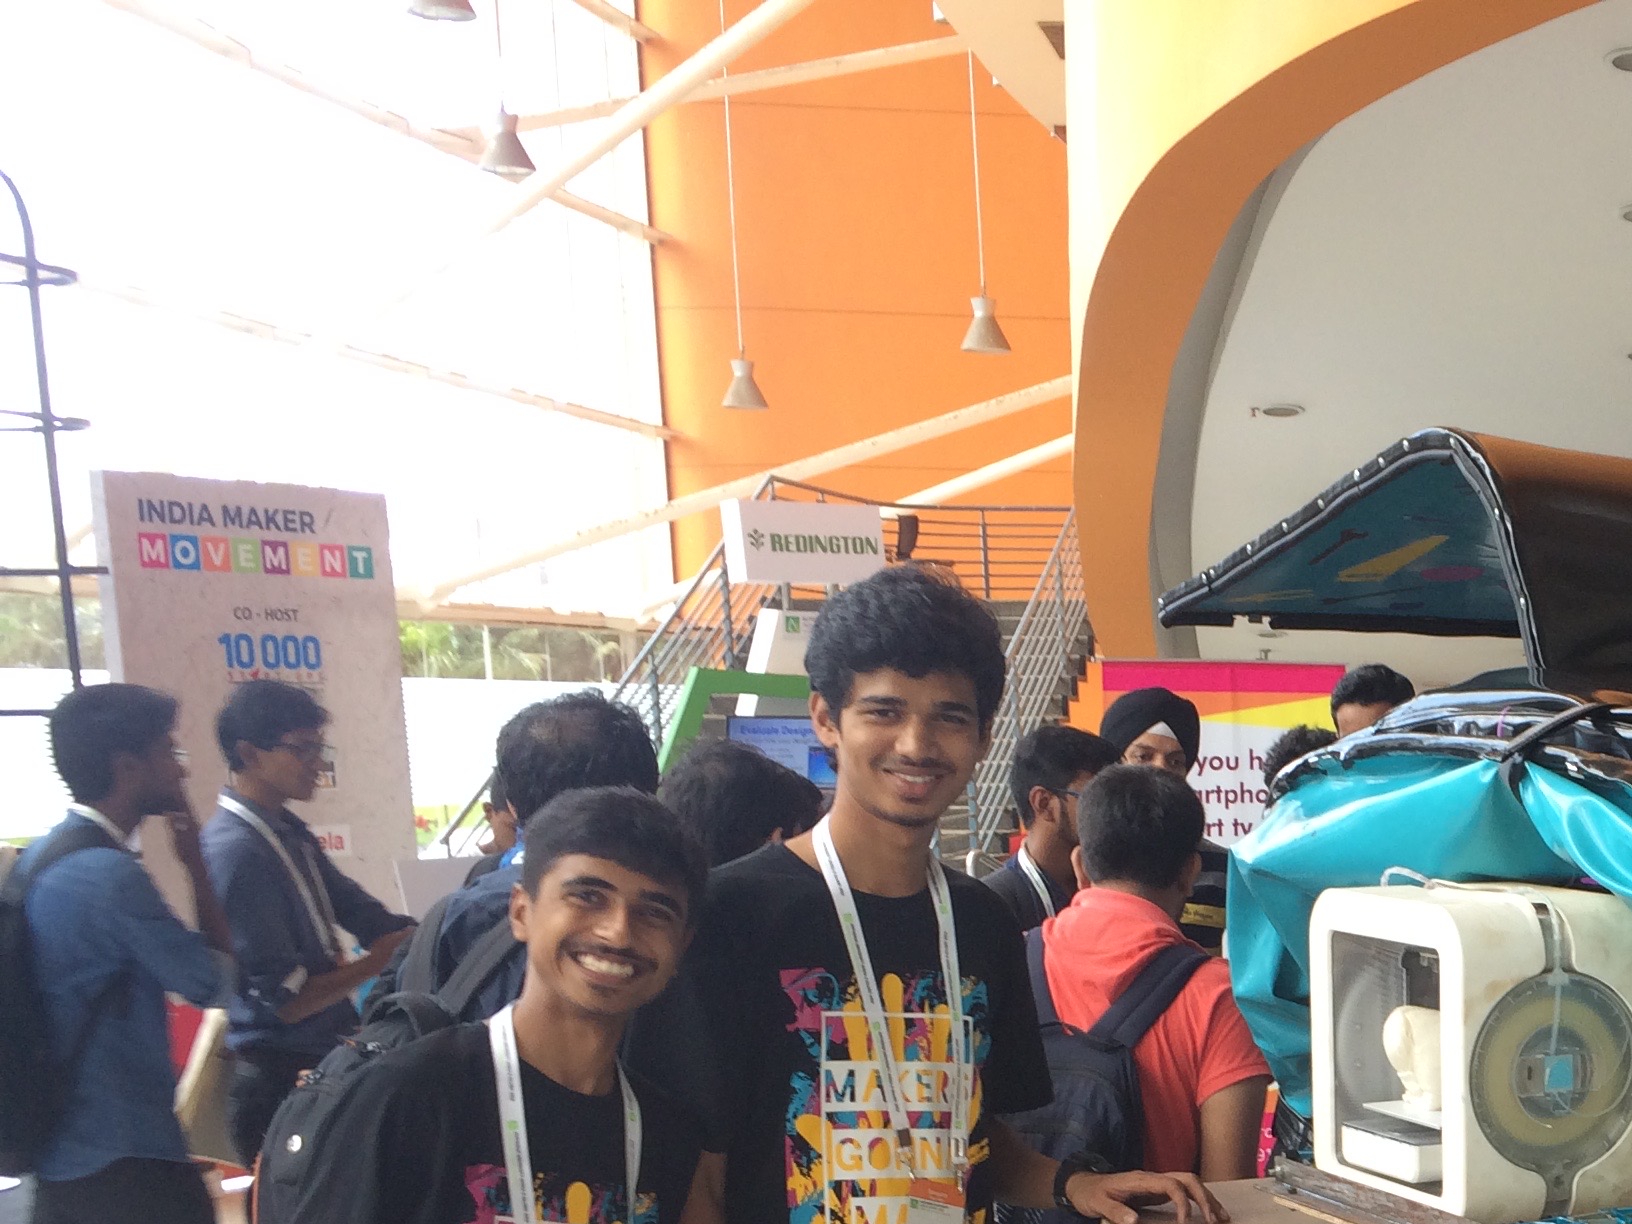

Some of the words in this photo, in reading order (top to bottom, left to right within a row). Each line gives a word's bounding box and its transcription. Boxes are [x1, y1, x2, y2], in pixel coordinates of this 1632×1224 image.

[138, 497, 216, 527] INDIA
[221, 504, 316, 534] MAKER
[769, 533, 879, 555] REDINGTON
[140, 534, 371, 577] MOVEMENT
[265, 607, 299, 622] HOST
[1196, 755, 1239, 776] you
[1232, 819, 1253, 837] tv
